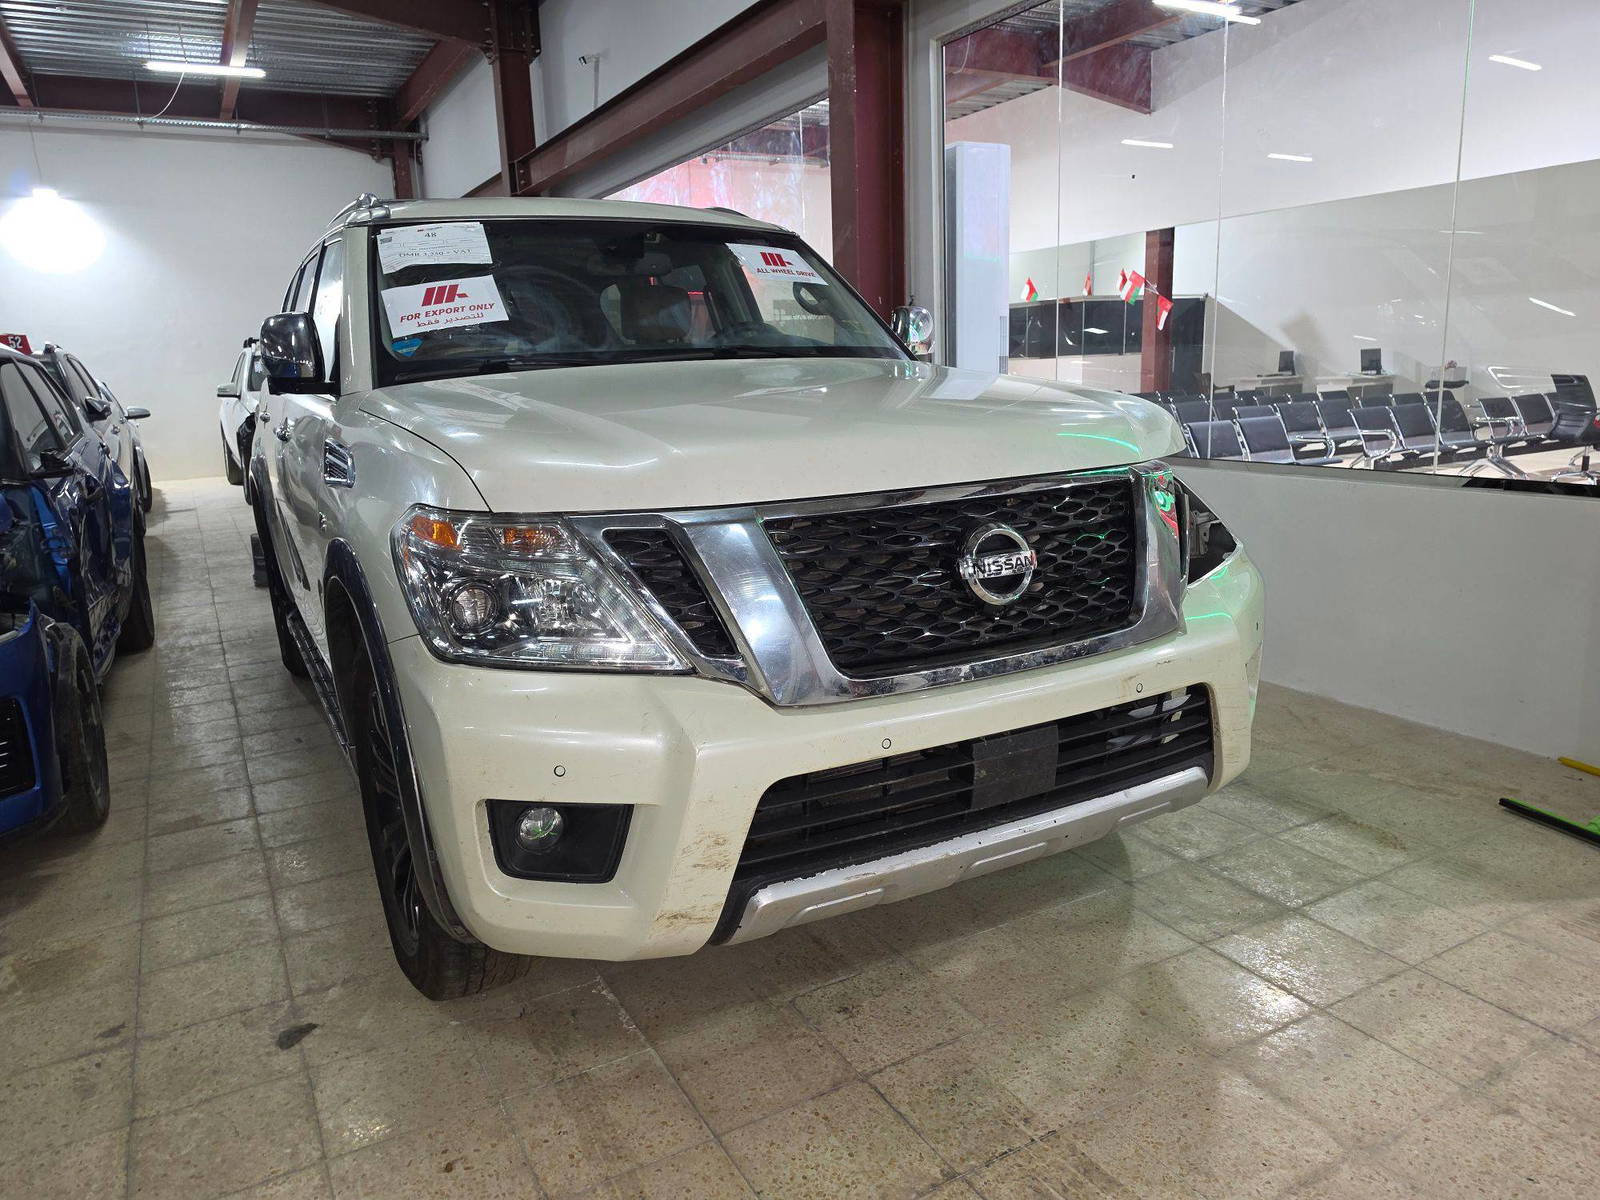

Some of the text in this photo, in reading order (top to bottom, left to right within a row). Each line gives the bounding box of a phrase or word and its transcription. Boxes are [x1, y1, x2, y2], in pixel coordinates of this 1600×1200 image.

[400, 302, 496, 323] FOR EXPORT ONLY
[416, 311, 484, 328] للتصدير فقط
[7, 336, 22, 348] 52
[972, 555, 1033, 575] NISSAN
